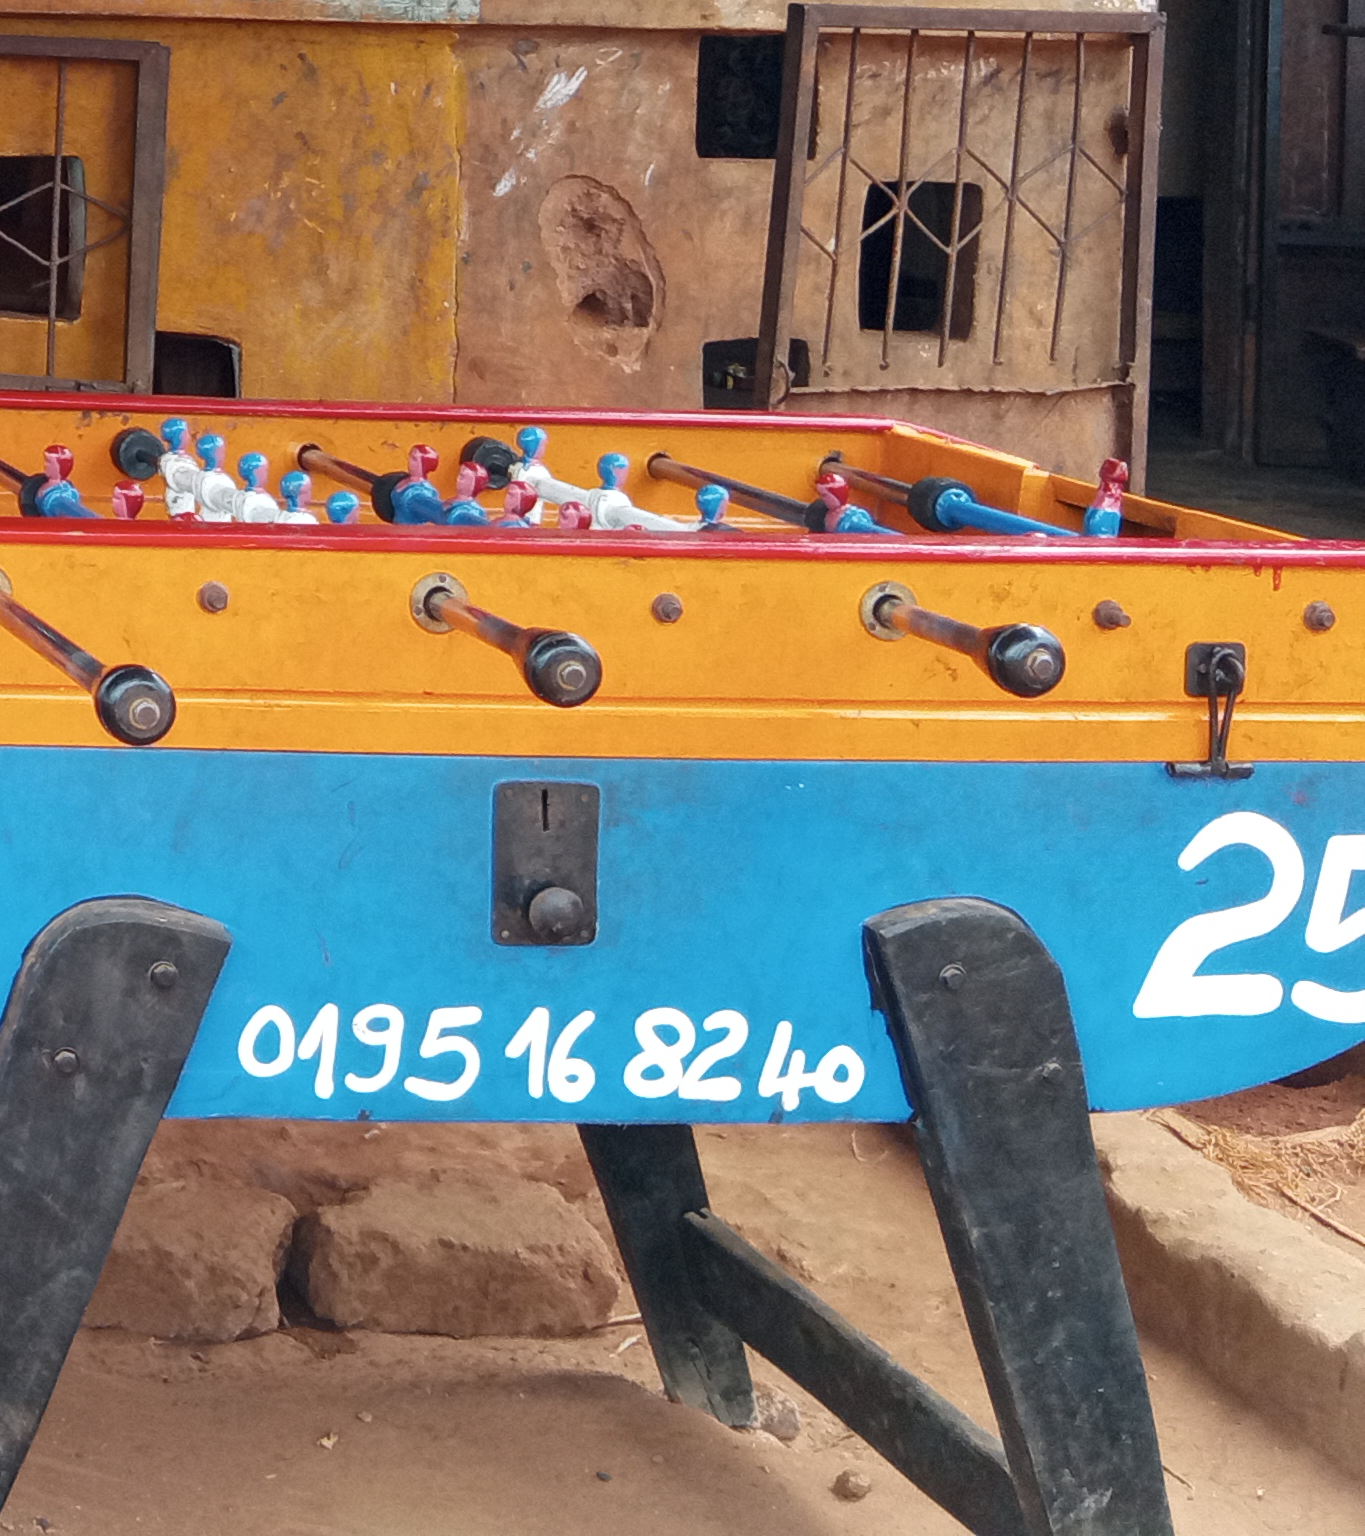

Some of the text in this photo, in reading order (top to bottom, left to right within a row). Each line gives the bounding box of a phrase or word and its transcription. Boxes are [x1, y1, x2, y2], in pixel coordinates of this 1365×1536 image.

[235, 1001, 866, 1112] 0195 16 82 40
